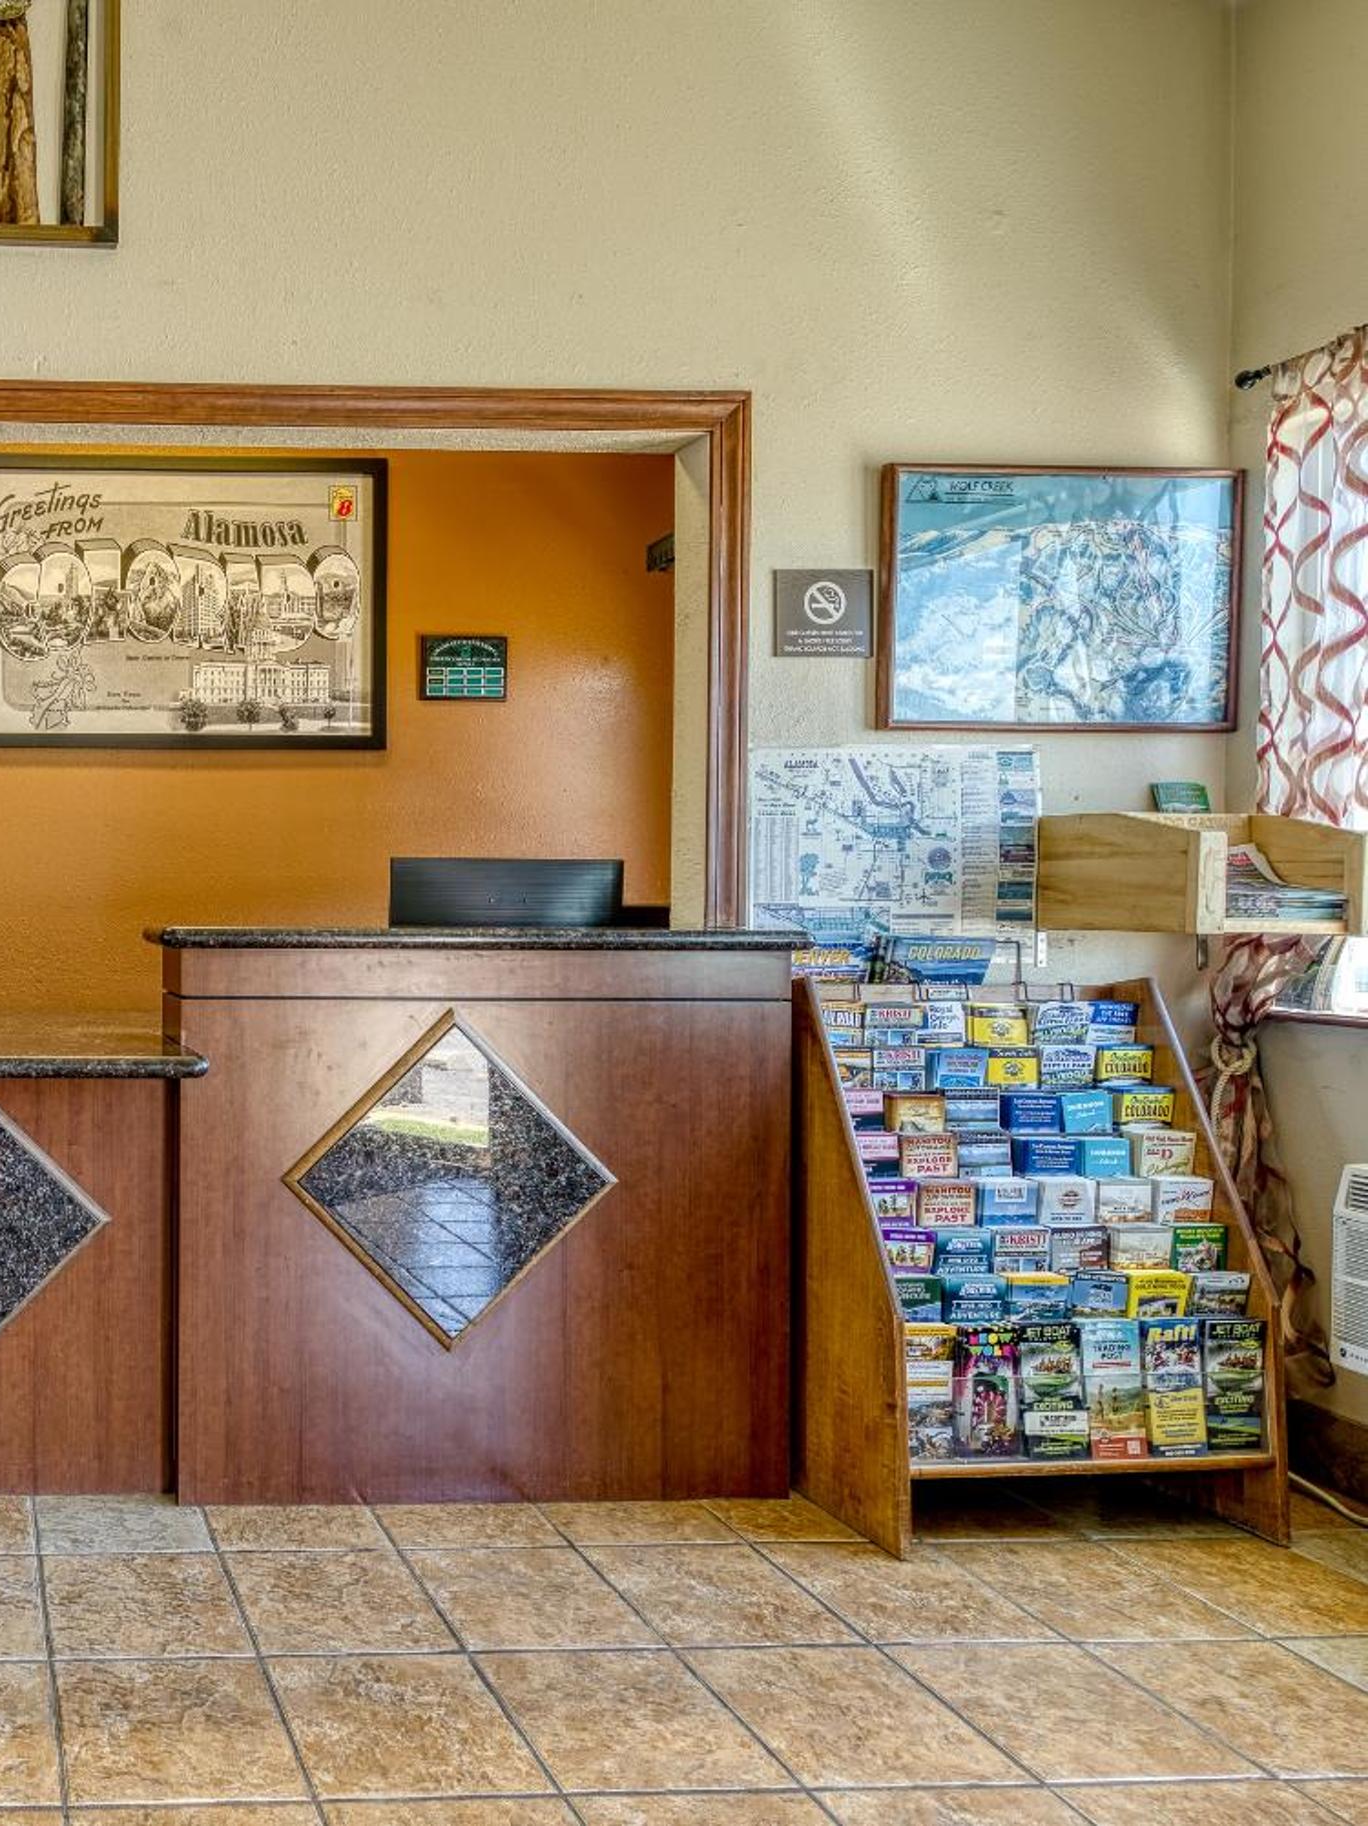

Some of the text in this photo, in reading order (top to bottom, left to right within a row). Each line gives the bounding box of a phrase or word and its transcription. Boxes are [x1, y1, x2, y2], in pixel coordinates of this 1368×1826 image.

[41, 517, 104, 539] FROM
[181, 508, 309, 548] Alamosa
[908, 946, 980, 961] COLORADO
[1125, 1105, 1170, 1117] COLORADO
[1024, 1325, 1071, 1338] JET BOAT
[1212, 1323, 1261, 1336] JET BOAT
